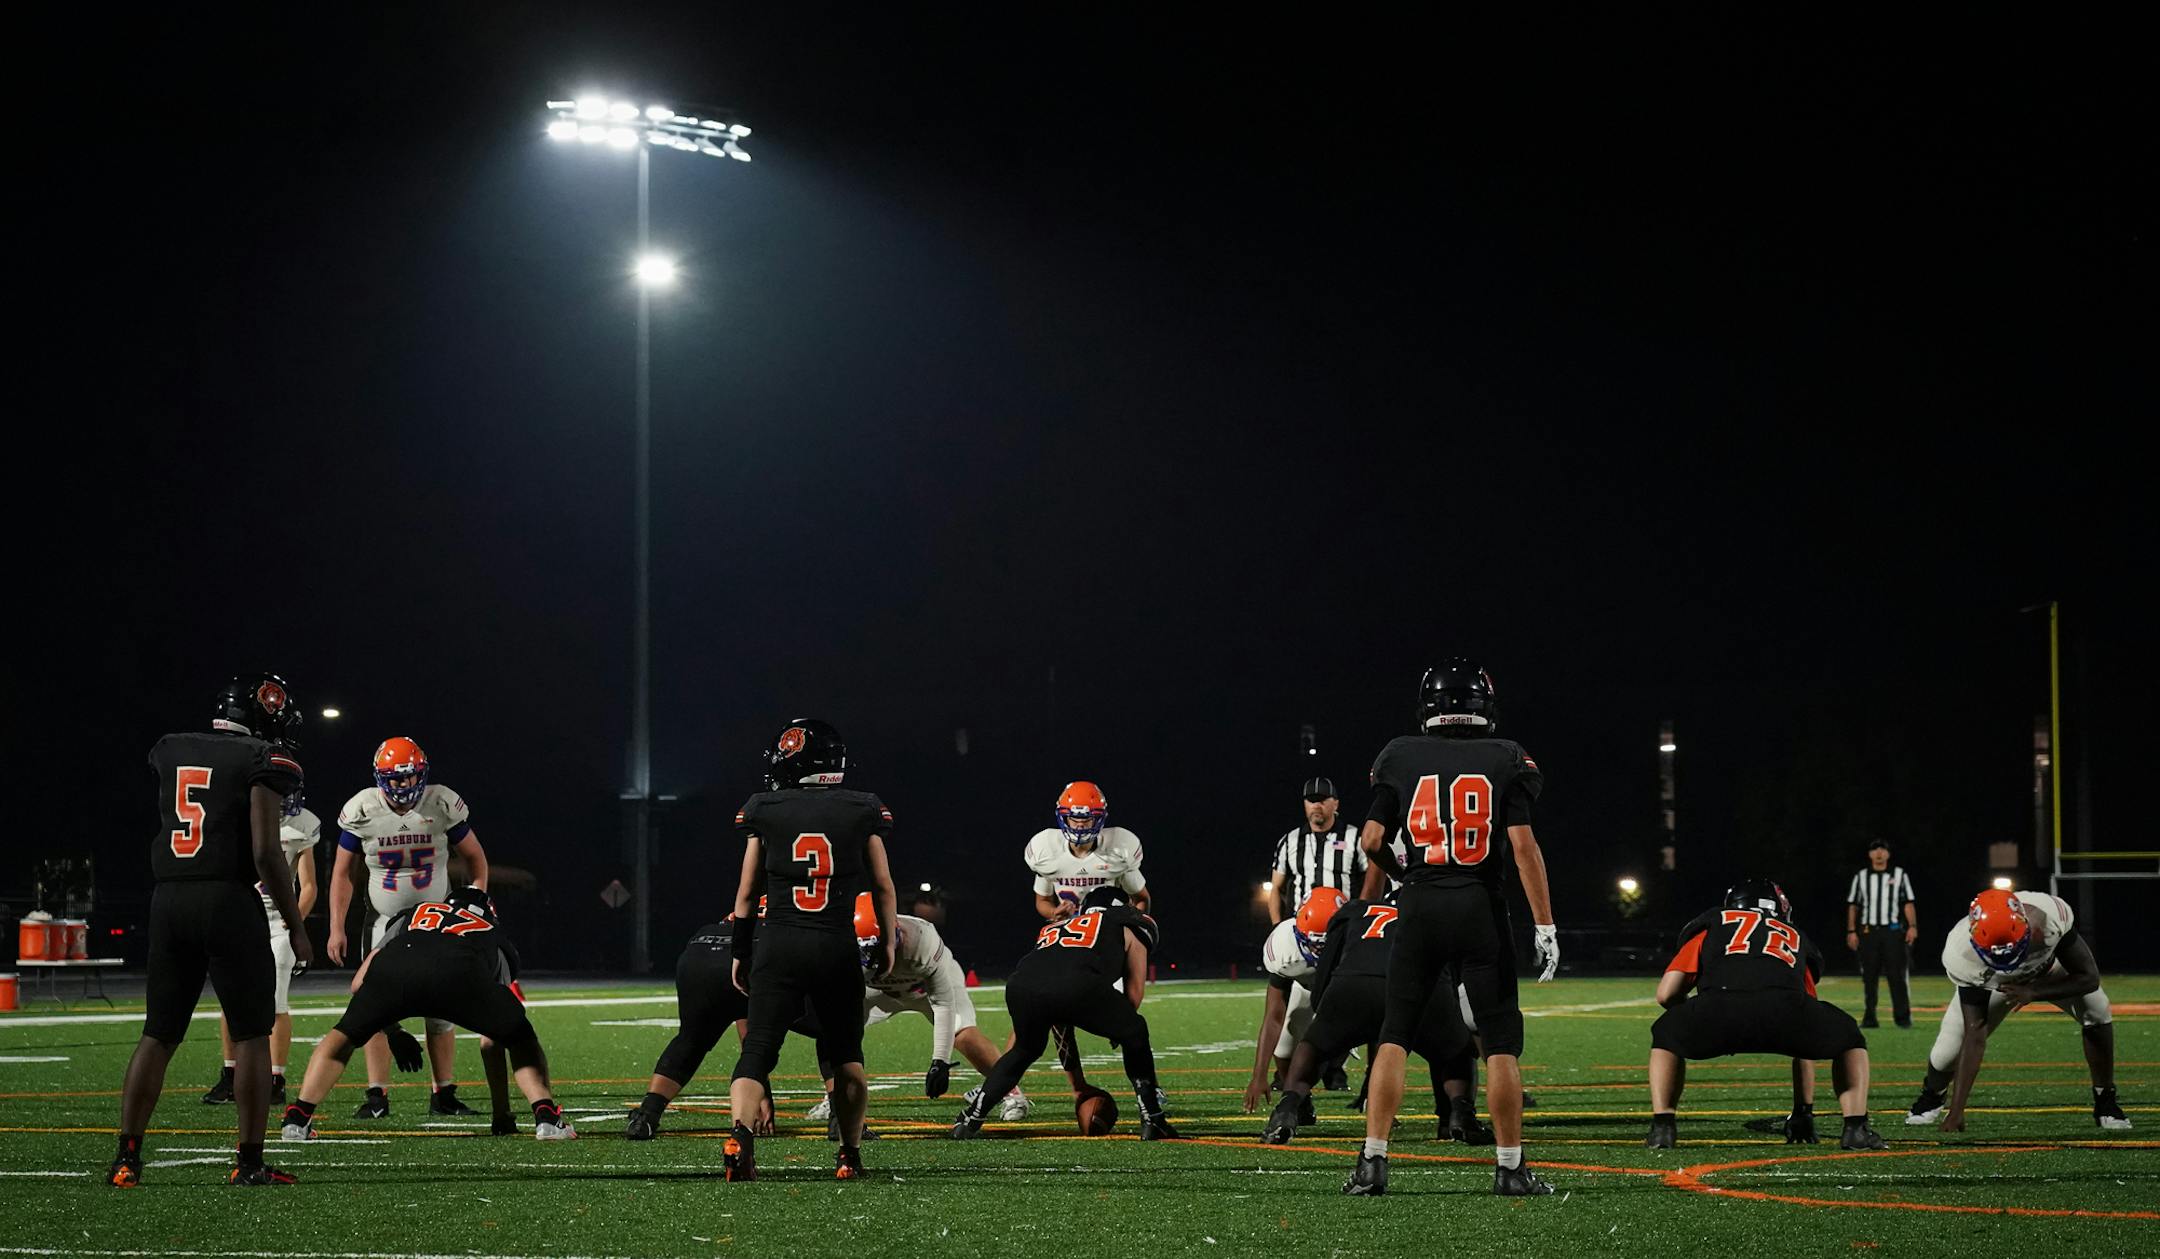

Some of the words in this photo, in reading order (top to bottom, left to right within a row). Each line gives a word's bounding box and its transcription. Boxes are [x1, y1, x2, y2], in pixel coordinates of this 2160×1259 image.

[171, 766, 213, 858] 5
[1407, 774, 1493, 865] 48
[378, 833, 432, 847] WASHBURN
[377, 847, 435, 892] 75
[792, 832, 834, 912] 3
[408, 902, 494, 937] 67
[1036, 911, 1104, 950] 59
[1721, 909, 1801, 968] 72
